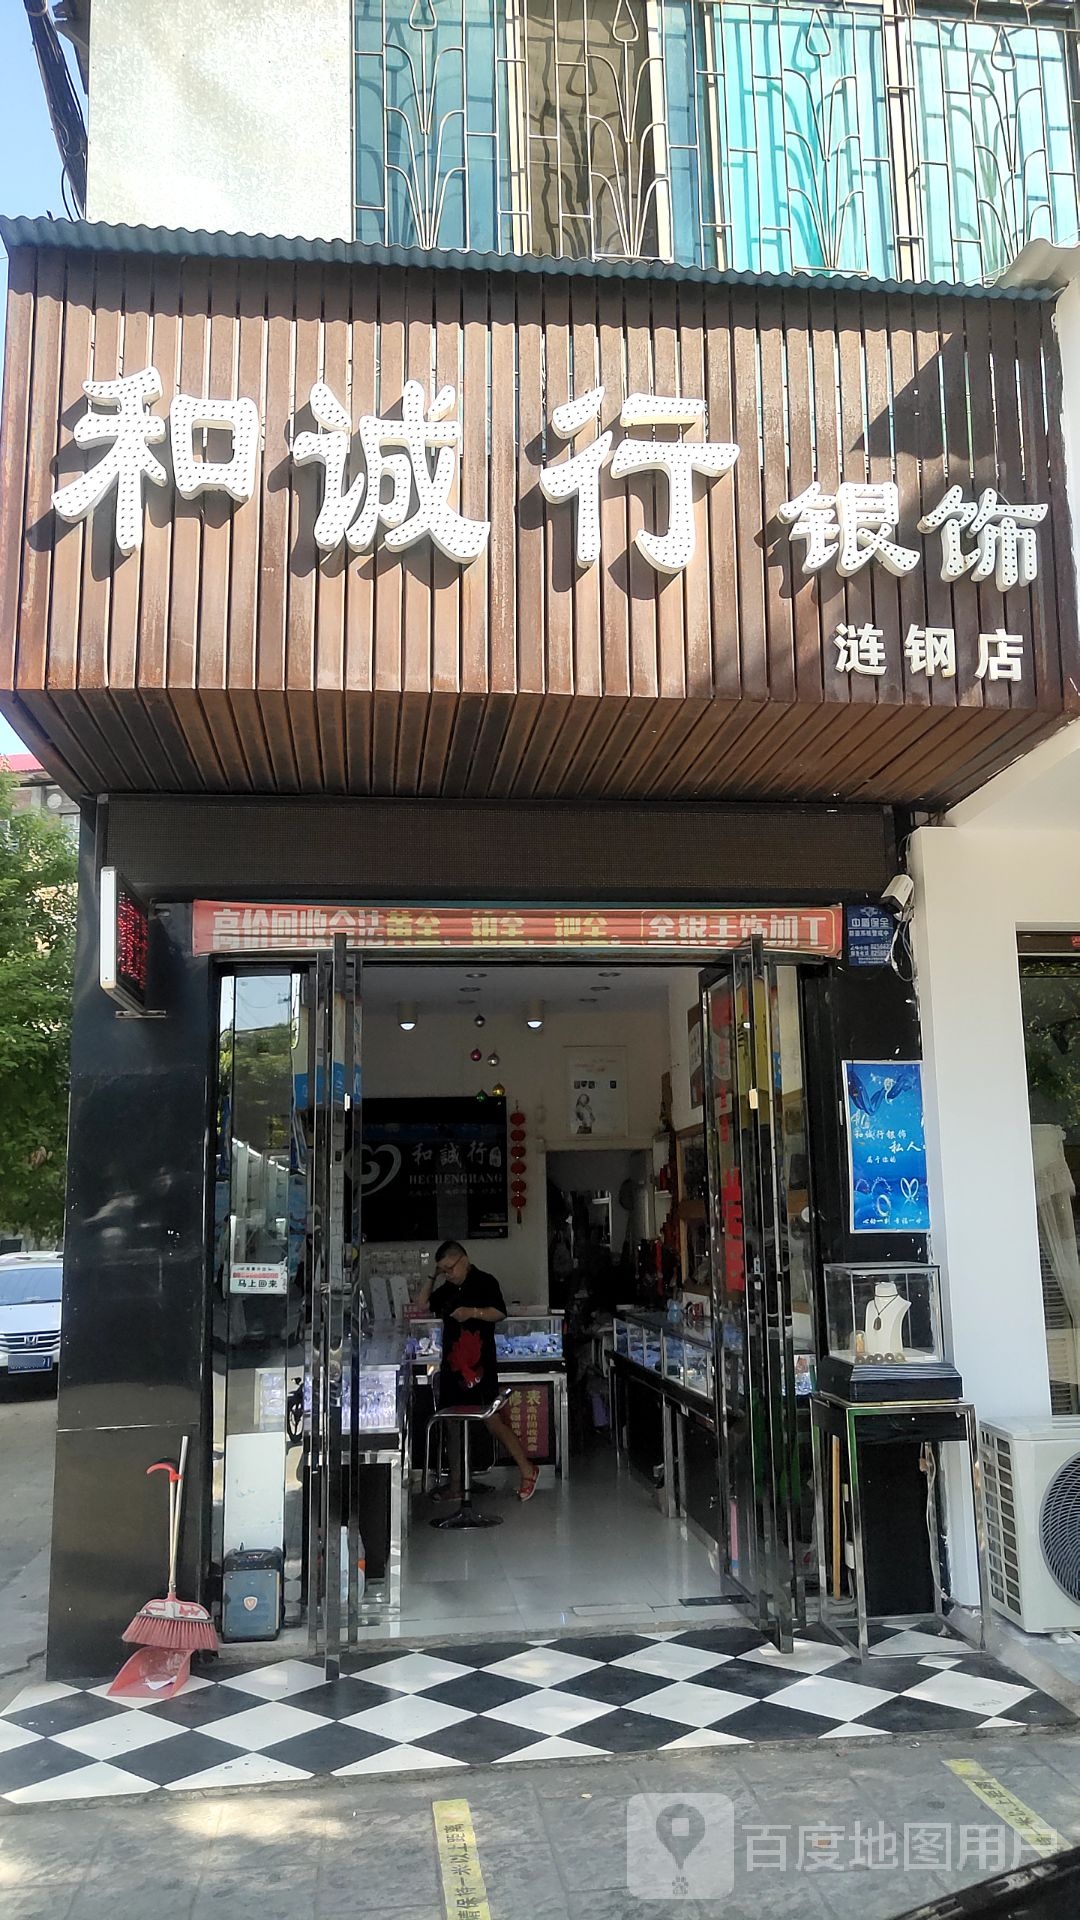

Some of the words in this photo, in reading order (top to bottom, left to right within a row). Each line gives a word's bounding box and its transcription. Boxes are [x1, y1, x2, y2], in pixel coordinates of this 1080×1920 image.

[51, 365, 741, 575] 和诚行
[777, 480, 1049, 592] 银饰
[833, 622, 1025, 683] 涟钢店
[408, 1173, 503, 1185] HECHENGHANG
